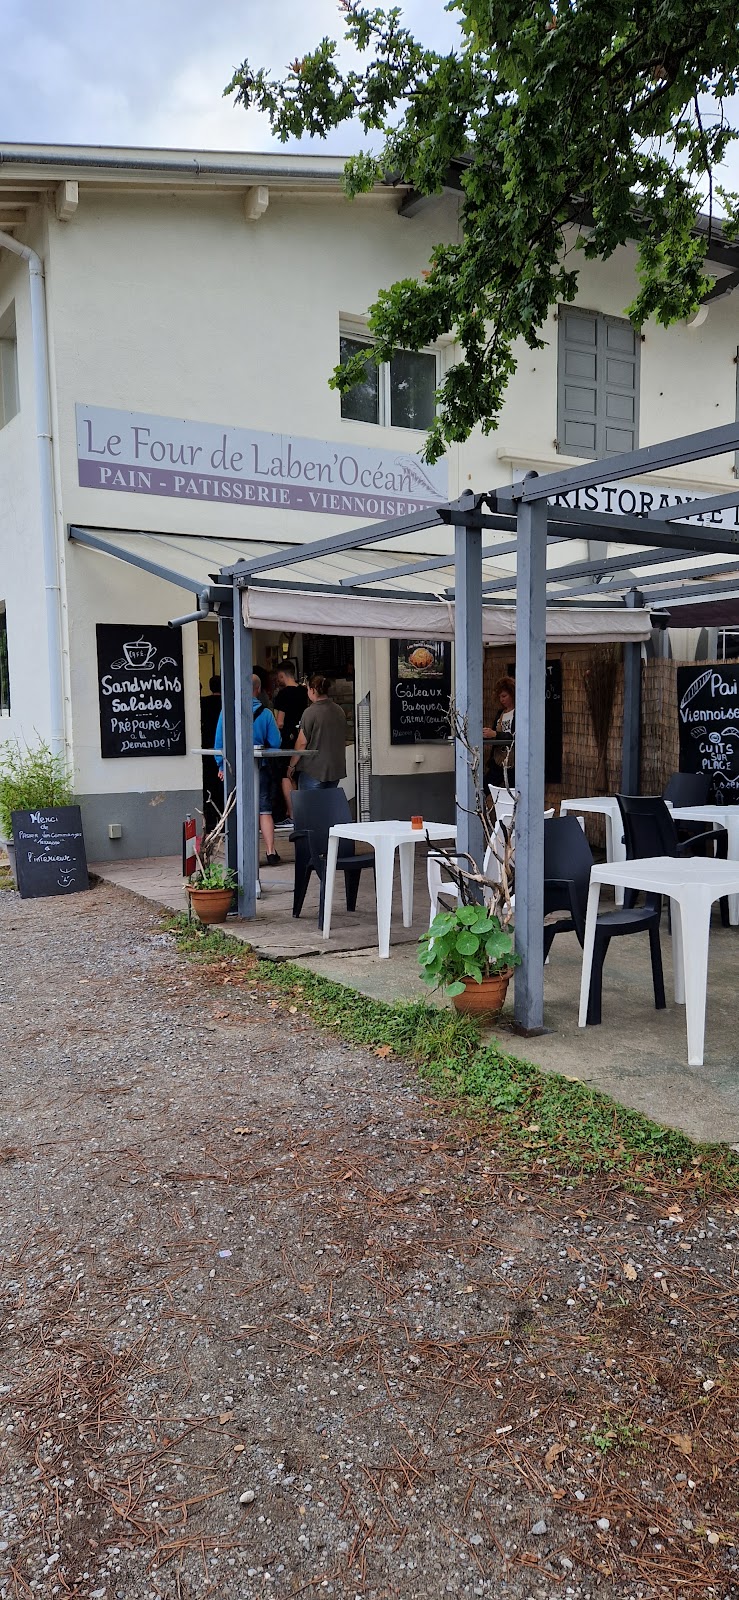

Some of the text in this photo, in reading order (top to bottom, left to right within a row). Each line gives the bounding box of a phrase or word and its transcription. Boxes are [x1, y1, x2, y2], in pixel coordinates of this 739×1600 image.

[83, 419, 415, 493] Le Four de Laben'Océan
[99, 466, 152, 489] PAIN
[173, 475, 291, 504] PATISSERIE
[308, 491, 434, 517] VIENNOISER
[101, 674, 182, 696] Sandwichs
[111, 696, 172, 713] Salades
[402, 700, 443, 715] Basques
[699, 742, 734, 755] CUITS
[711, 752, 728, 761] SUR
[702, 759, 731, 771] PLACE
[30, 811, 59, 824] Merci
